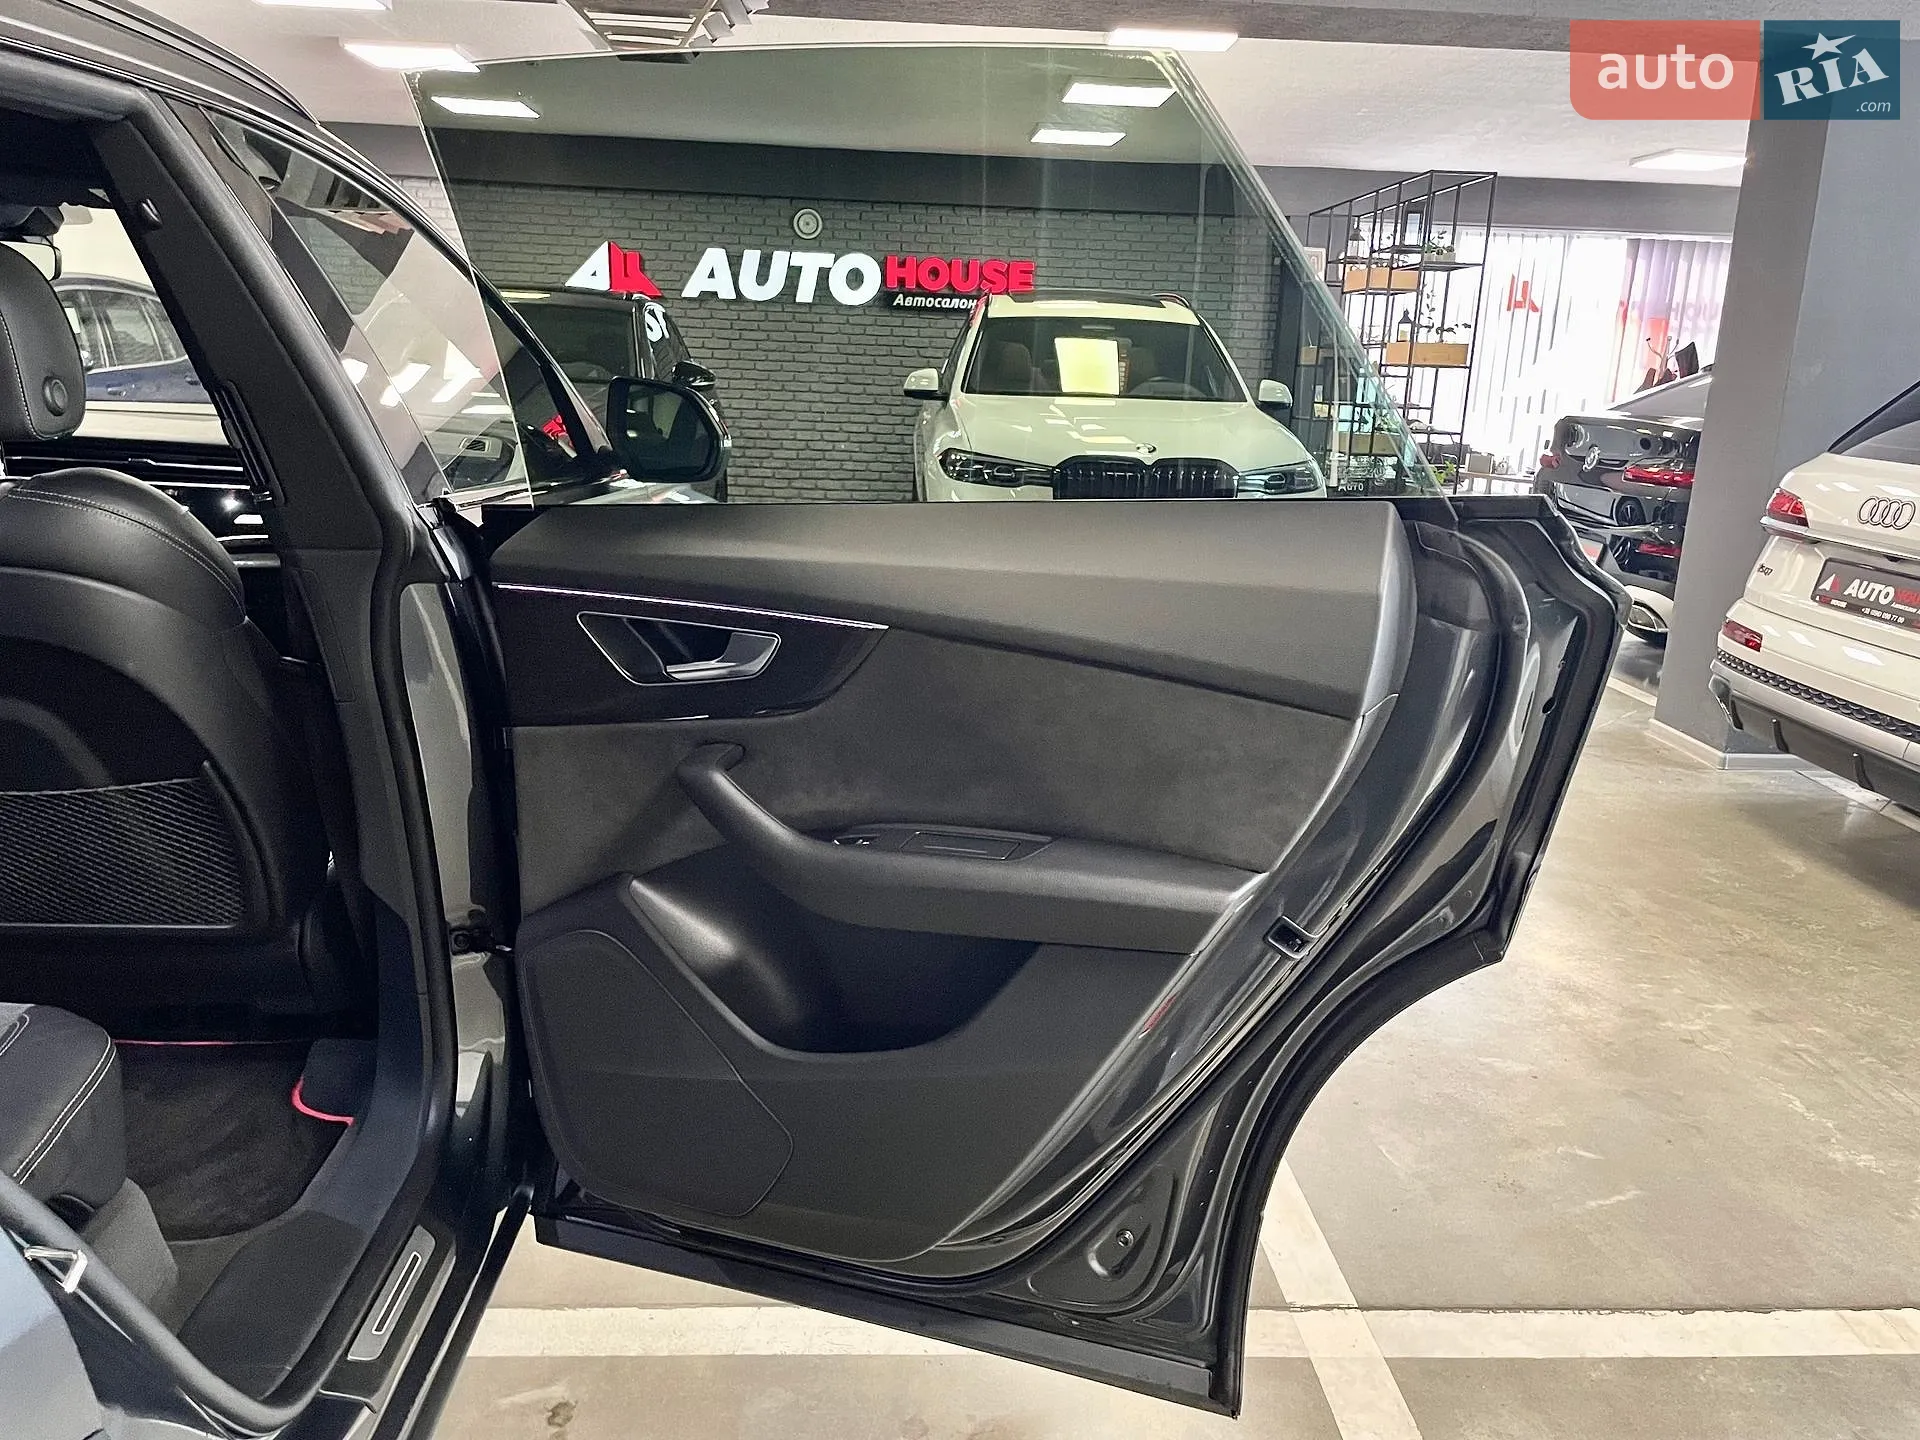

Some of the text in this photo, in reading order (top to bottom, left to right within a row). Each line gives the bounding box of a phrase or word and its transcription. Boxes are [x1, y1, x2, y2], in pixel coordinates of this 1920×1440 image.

[681, 247, 1036, 306] AUTO HOUSE
[892, 293, 978, 310] Автосалон
[1843, 578, 1895, 606] AUTO
